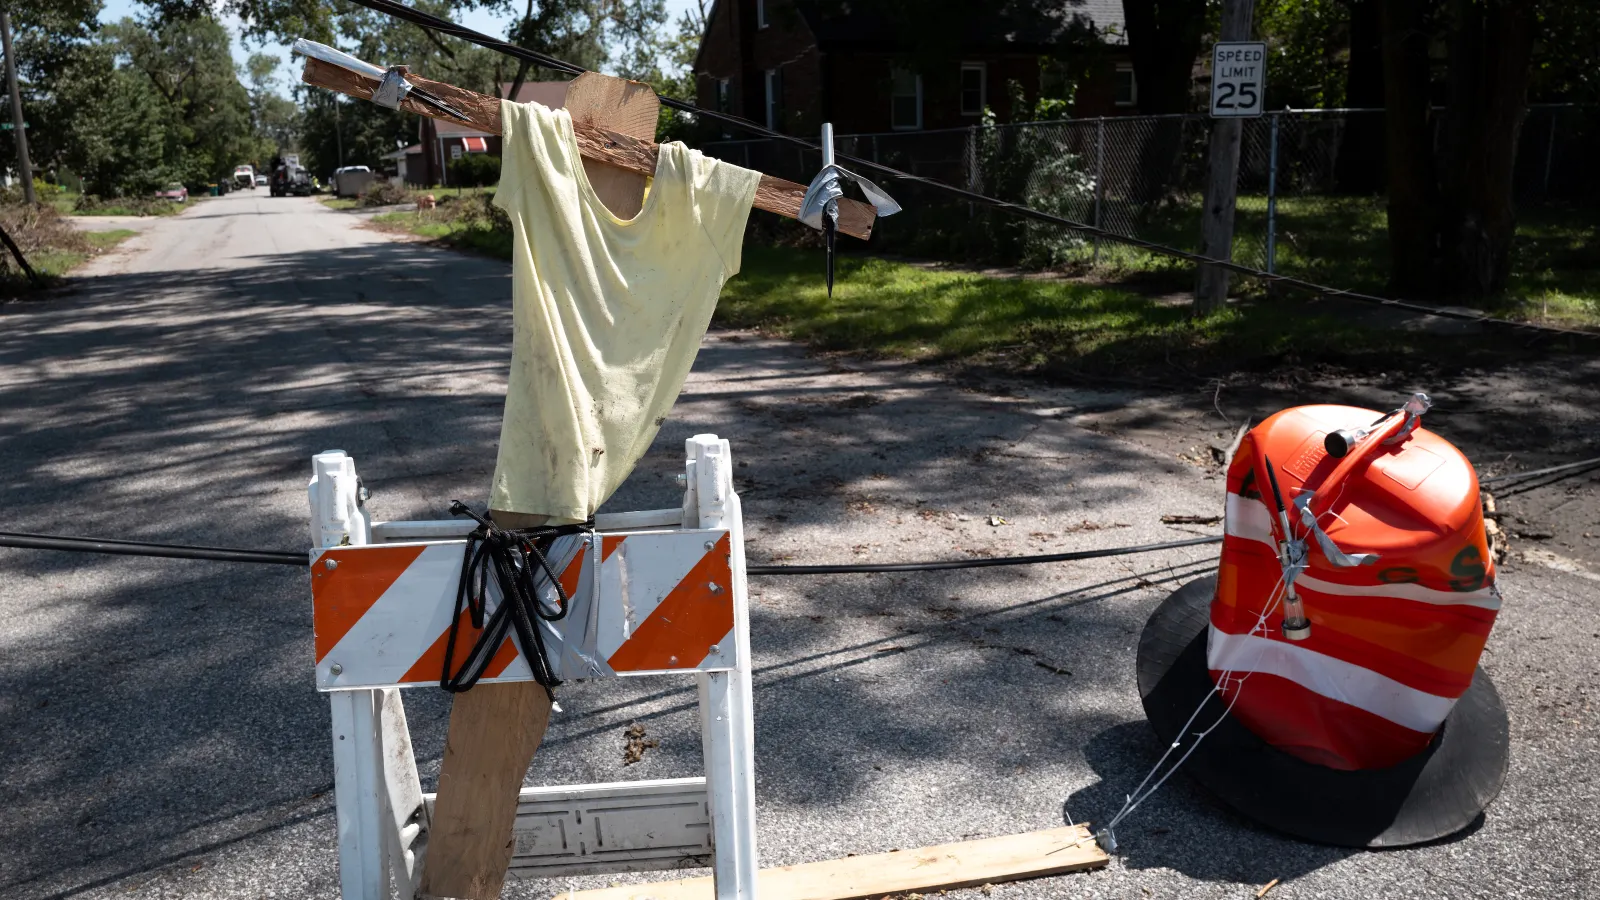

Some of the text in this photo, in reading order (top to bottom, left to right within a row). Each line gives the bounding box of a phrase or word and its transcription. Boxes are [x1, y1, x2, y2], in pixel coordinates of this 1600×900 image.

[1217, 50, 1262, 62] SPEED
[1221, 66, 1255, 78] LIMIT
[1215, 82, 1257, 109] 25
